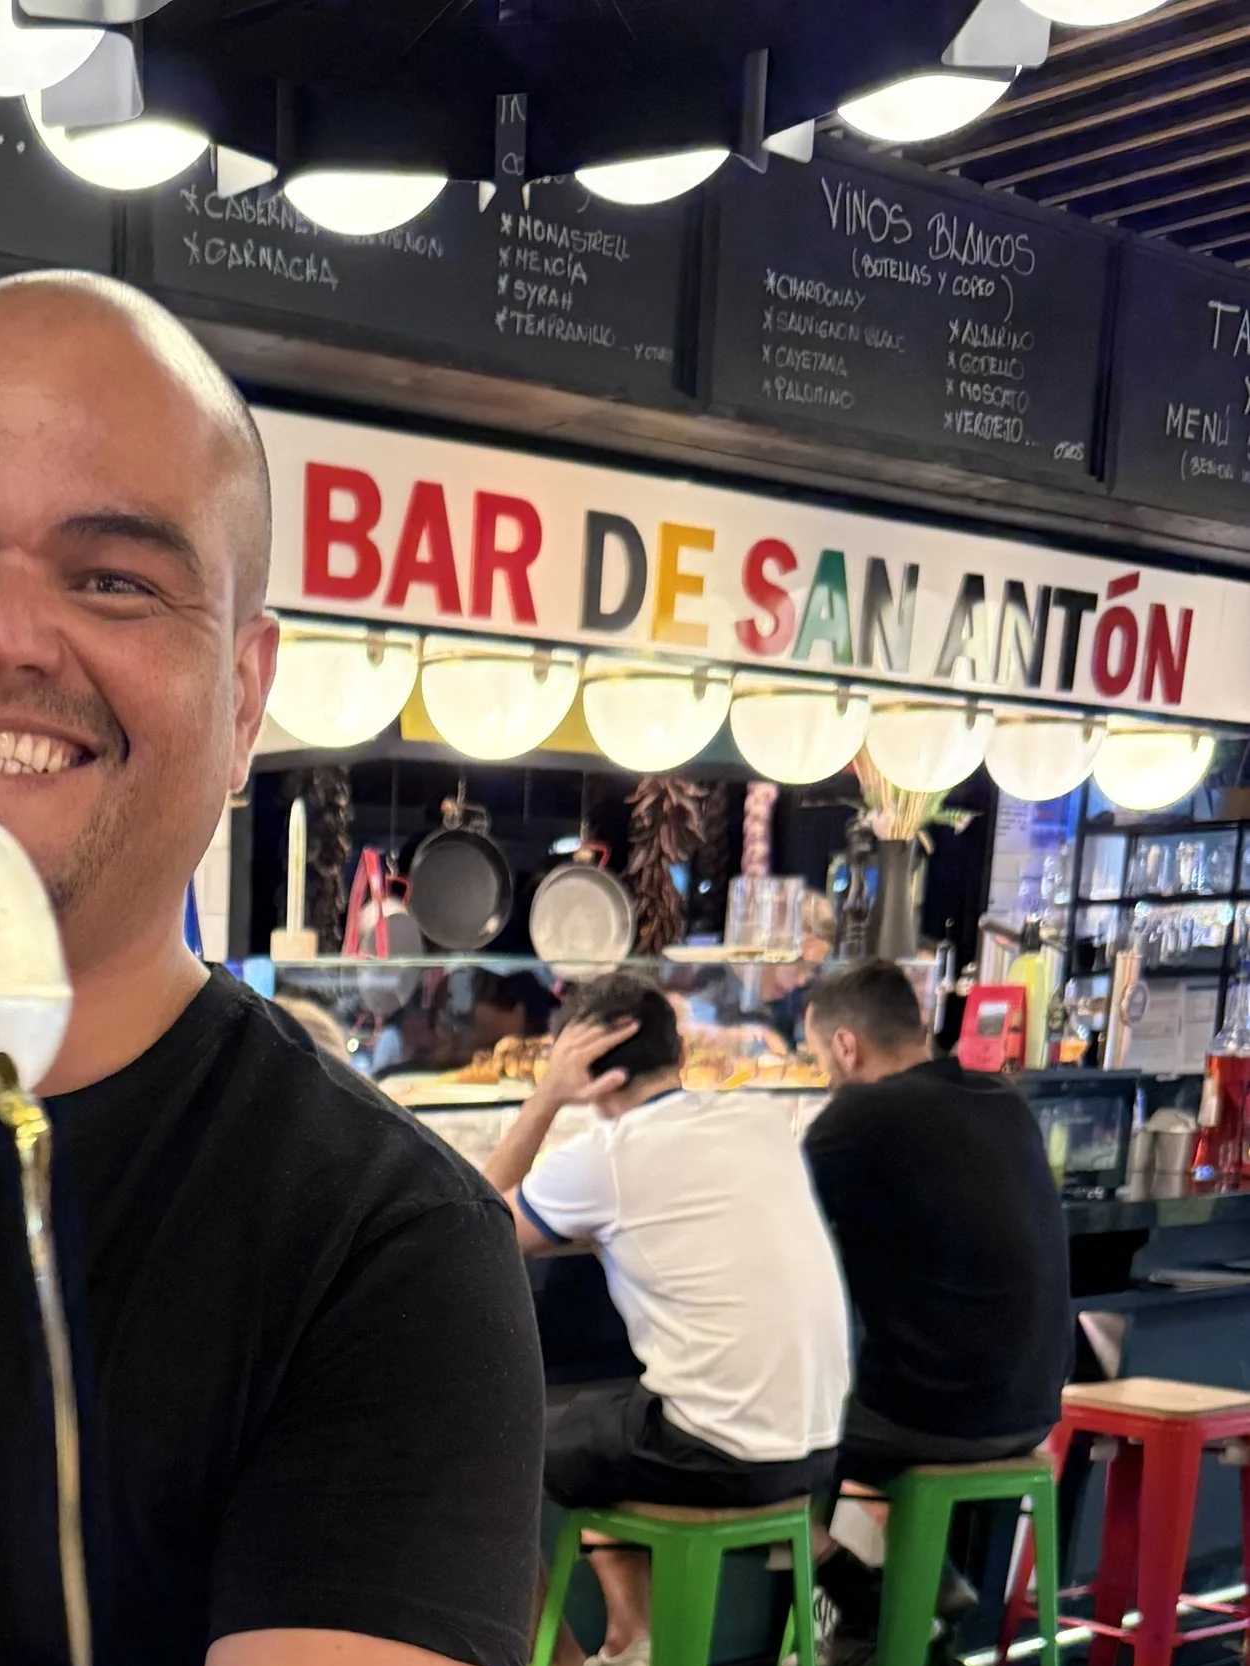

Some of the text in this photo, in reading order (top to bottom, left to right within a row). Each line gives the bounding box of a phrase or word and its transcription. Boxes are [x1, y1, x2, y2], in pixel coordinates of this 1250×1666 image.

[518, 215, 631, 263] MONASTRELL
[821, 176, 1035, 276] VINOS BLANCOS
[204, 238, 339, 291] GARNACHA
[513, 279, 574, 312] SYRAH
[938, 271, 947, 295] Y
[776, 311, 860, 342] SAUVIGNON
[774, 345, 848, 377] CAYETANA
[958, 352, 1026, 381] GODELLO
[774, 376, 854, 410] PALOMINO
[959, 380, 1030, 415] MOSCATO
[302, 461, 1194, 706] BAR DE SAN ANTÓN
